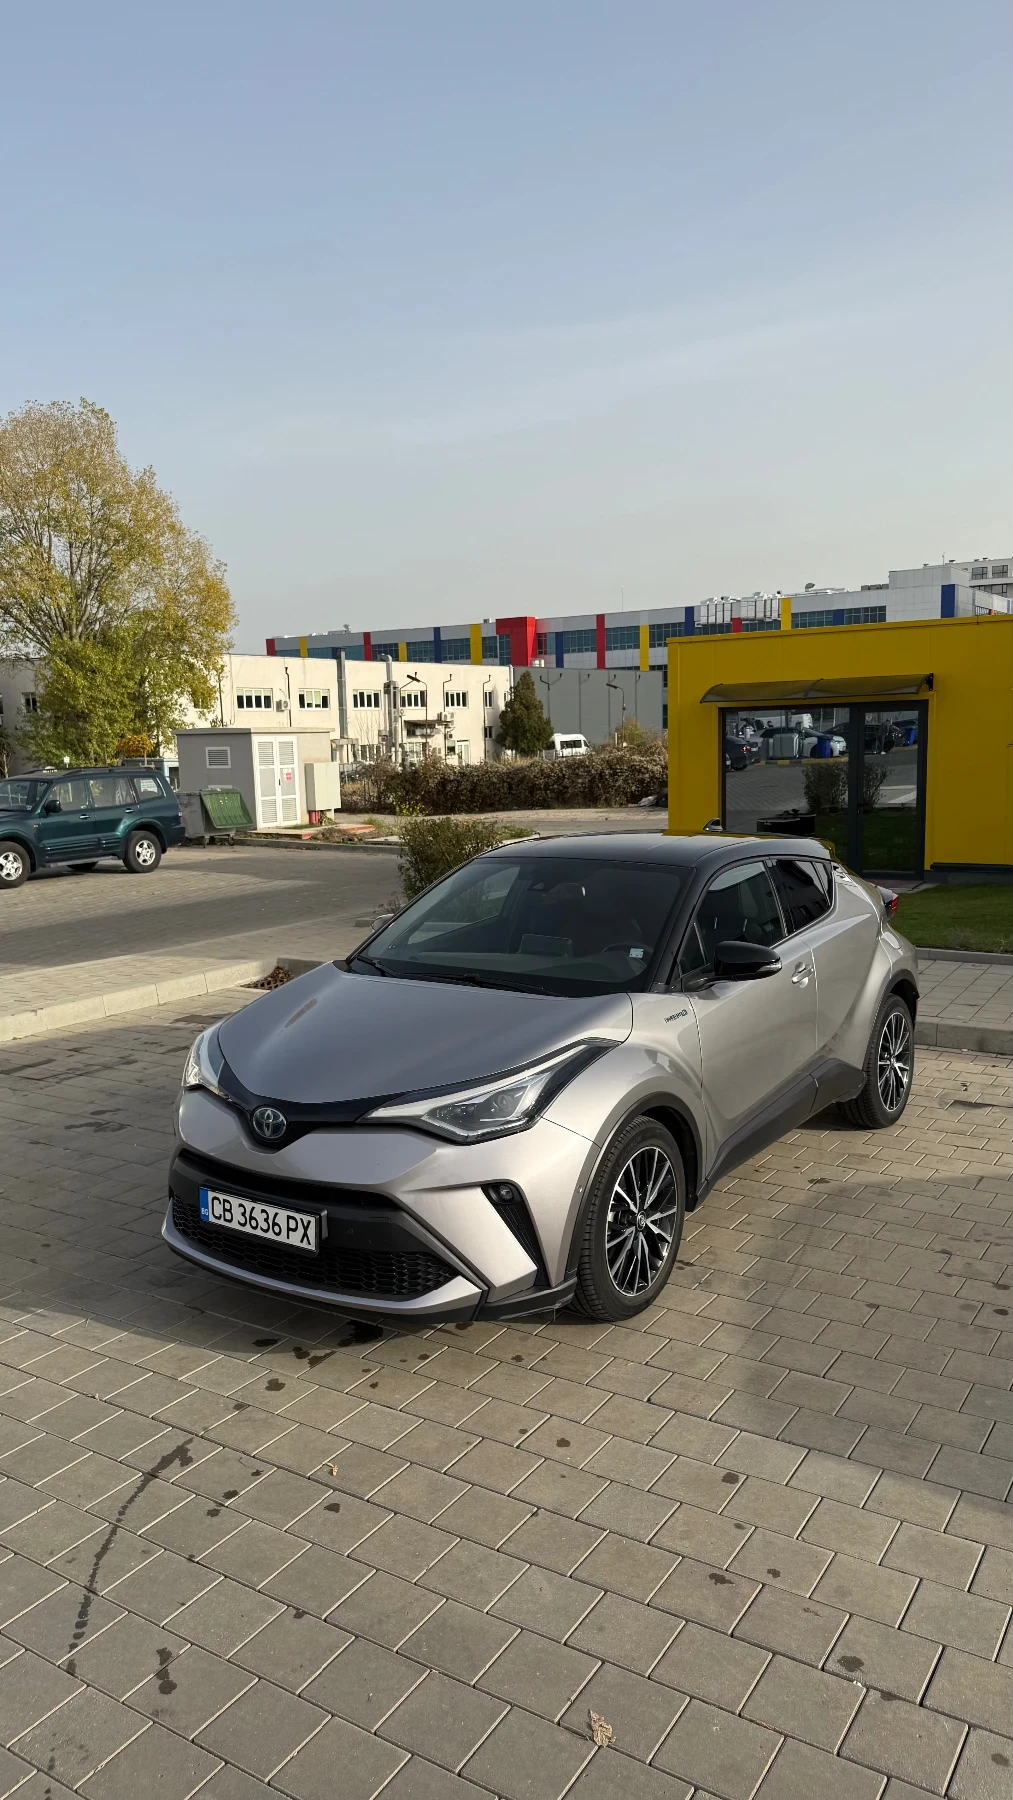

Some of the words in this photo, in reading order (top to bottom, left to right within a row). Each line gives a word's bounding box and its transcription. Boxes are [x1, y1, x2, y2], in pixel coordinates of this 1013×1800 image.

[211, 1196, 233, 1223] CB
[237, 1203, 282, 1236] 3636
[286, 1215, 311, 1246] PX
